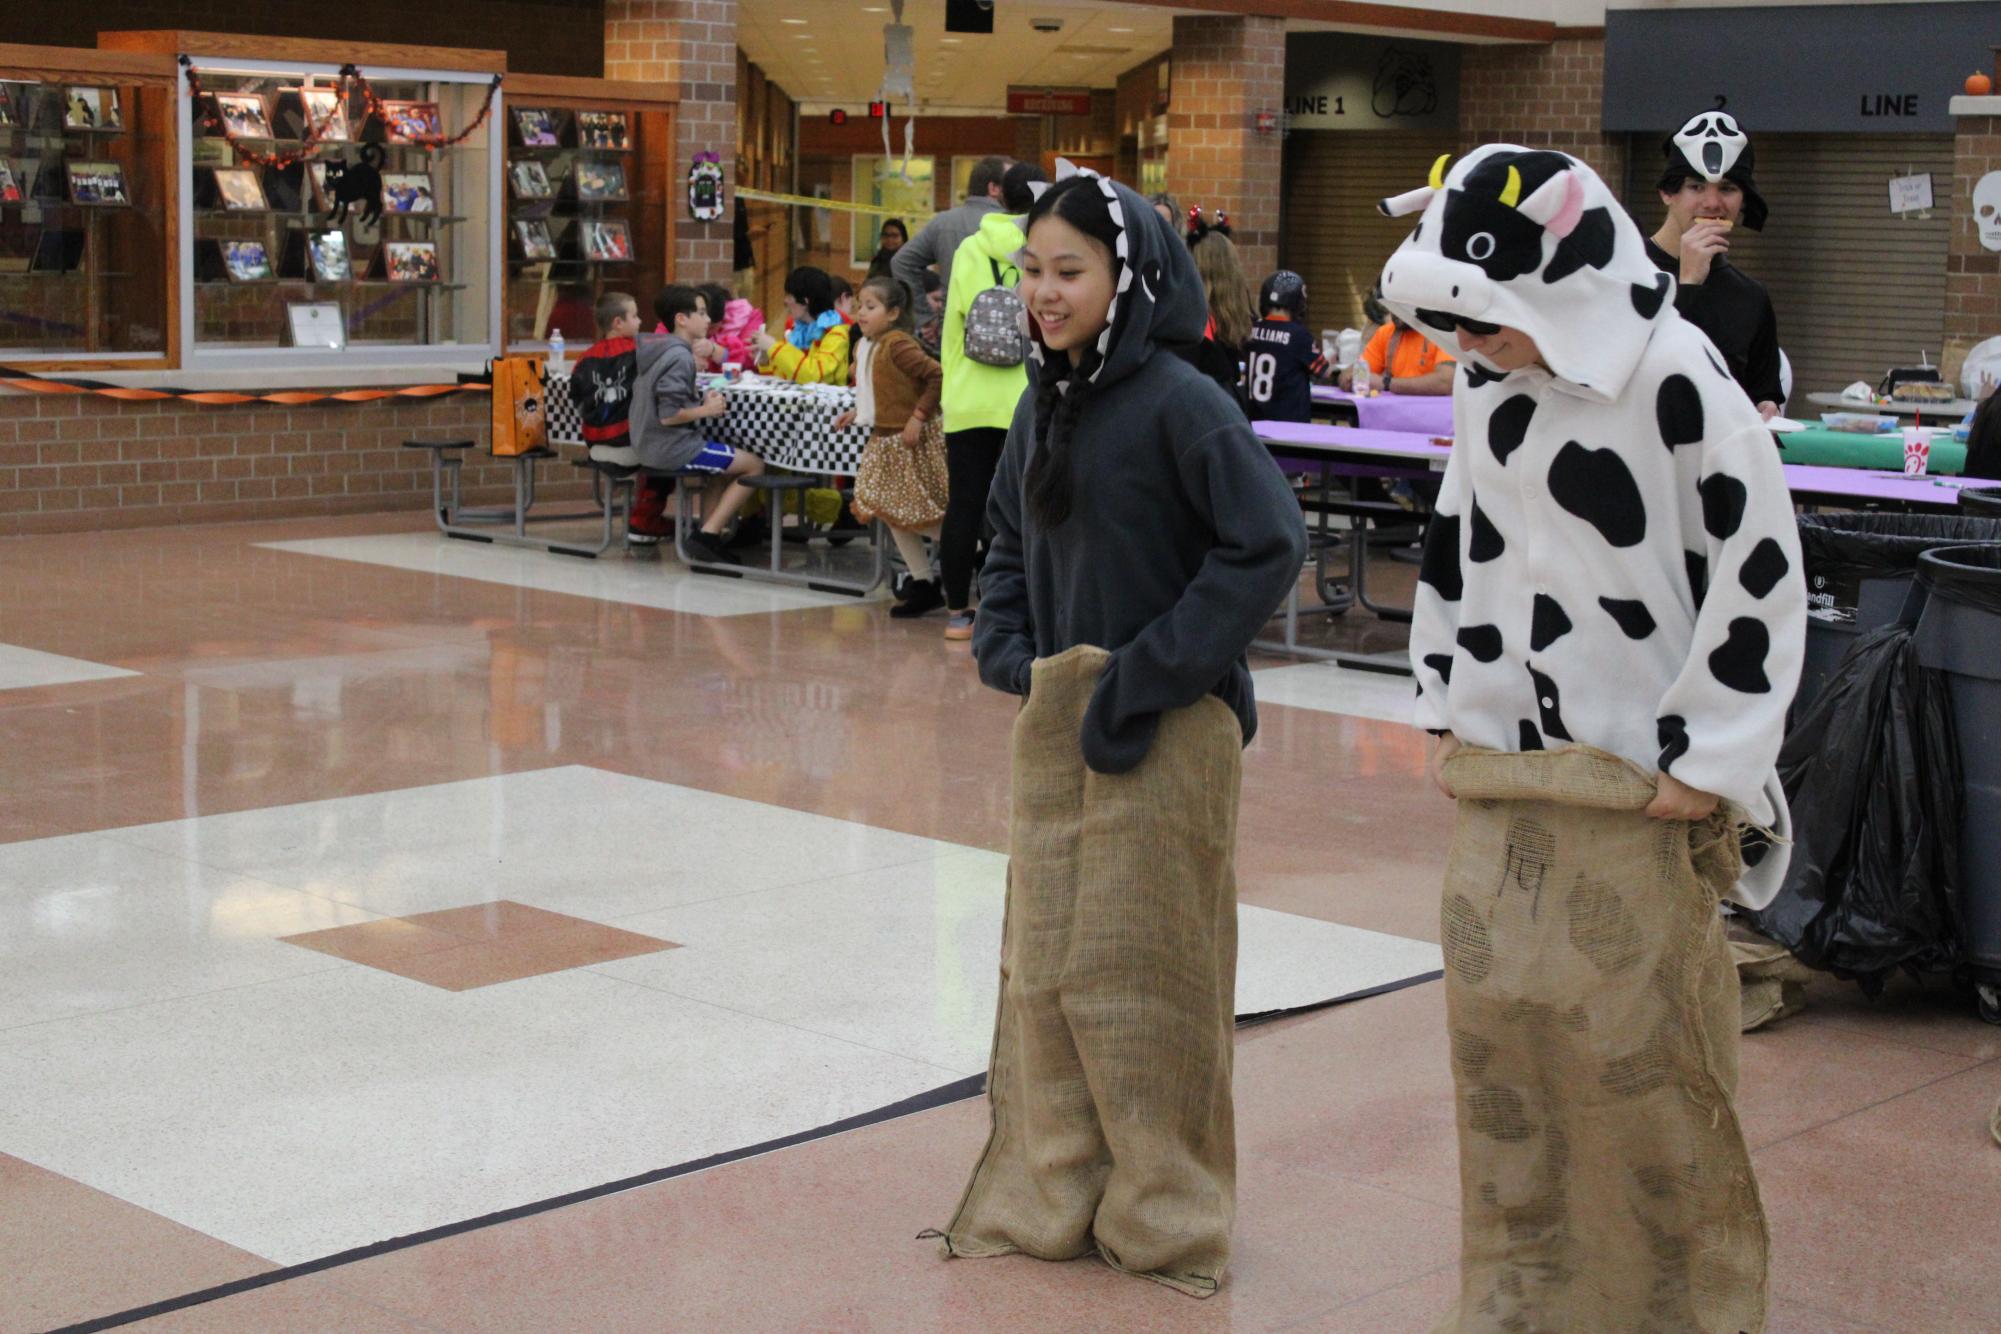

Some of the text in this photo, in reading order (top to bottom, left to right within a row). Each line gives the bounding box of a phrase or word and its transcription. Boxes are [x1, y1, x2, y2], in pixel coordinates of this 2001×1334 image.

[1284, 96, 1345, 114] LINE 1
[1860, 95, 1919, 116] LINE
[1251, 327, 1291, 345] ILLIAMS
[1248, 351, 1277, 402] 18
[1807, 592, 1835, 607] andfill
